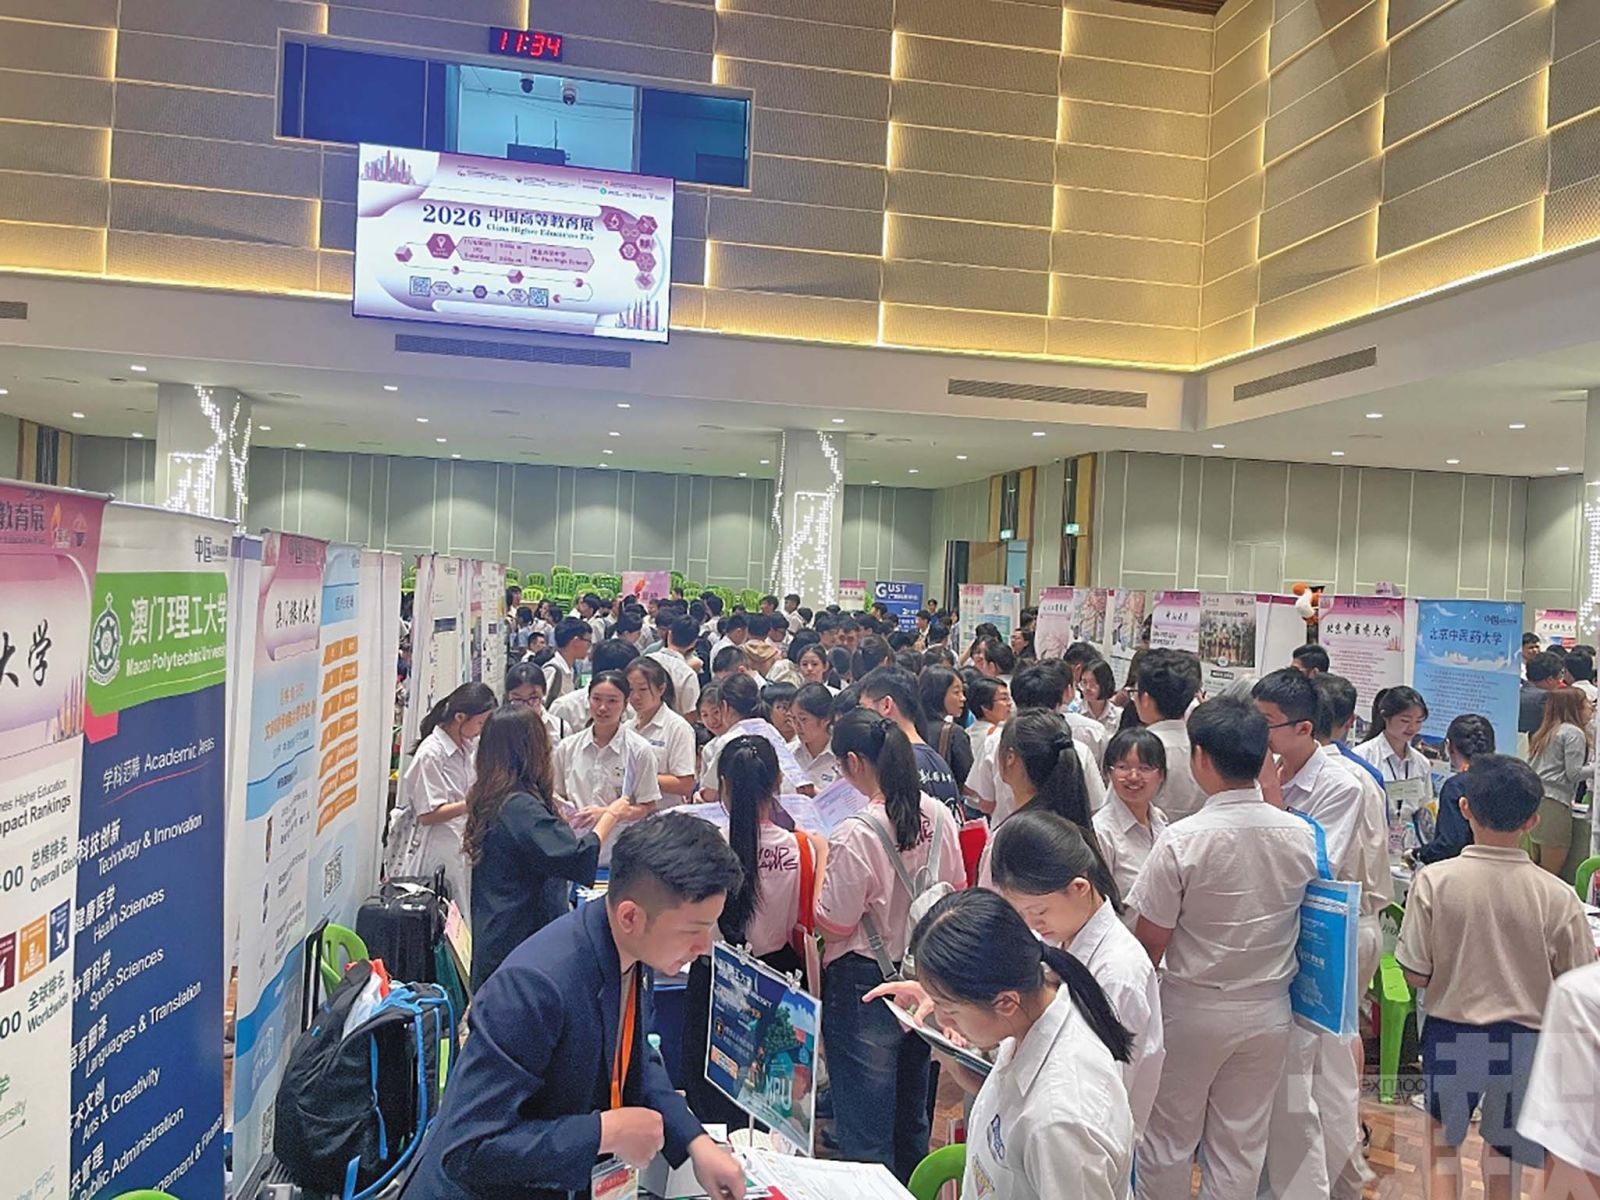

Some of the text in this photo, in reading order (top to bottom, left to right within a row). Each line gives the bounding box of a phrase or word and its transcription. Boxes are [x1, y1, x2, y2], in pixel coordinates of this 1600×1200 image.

[499, 31, 561, 57] 11:34
[422, 204, 481, 228] 2026
[1429, 627, 1503, 645] 北京中医药大学
[126, 658, 151, 677] Macao
[144, 744, 196, 772] Academic
[198, 737, 216, 755] Areas
[0, 795, 71, 838] pact Rankings
[143, 830, 151, 849] &
[154, 814, 202, 845] Innovation
[30, 864, 60, 892] Overall
[94, 888, 165, 944] Health Sciences
[90, 948, 164, 1011] Sports Sciences
[86, 981, 201, 1078] Languages & Translation
[101, 1104, 109, 1123] &
[111, 1067, 161, 1114] Creativity
[111, 1107, 184, 1178] Administration
